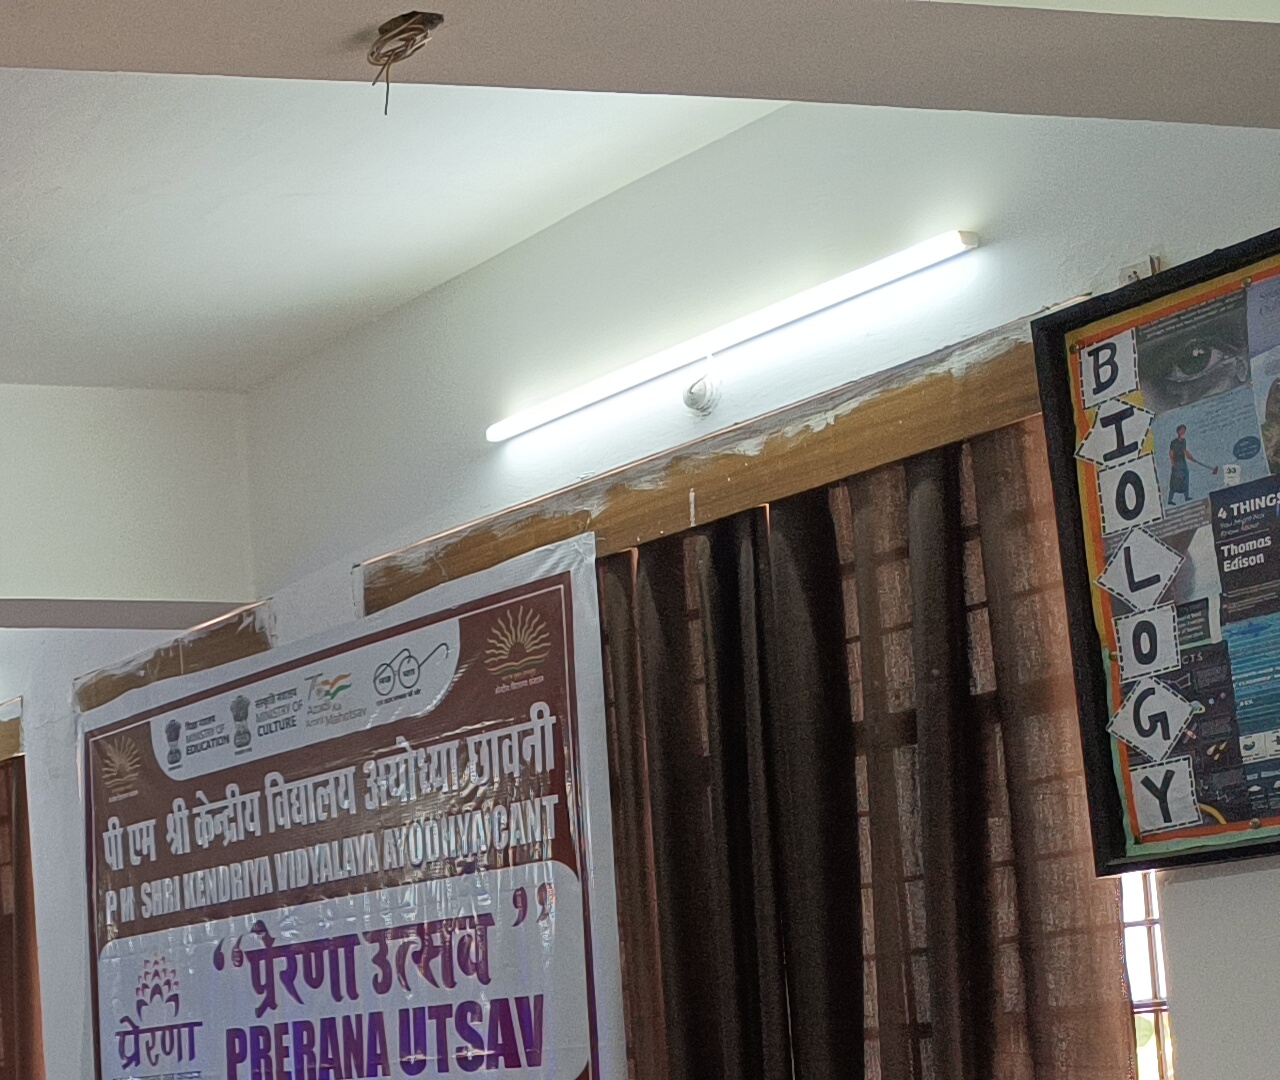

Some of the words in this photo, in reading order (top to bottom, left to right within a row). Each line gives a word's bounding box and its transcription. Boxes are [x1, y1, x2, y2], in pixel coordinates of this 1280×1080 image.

[1218, 507, 1227, 519] 4
[1220, 536, 1272, 557] Thomas
[1223, 553, 1265, 573] Edison
[257, 715, 297, 737] CULTURE
[186, 734, 230, 755] EDUCATION
[102, 816, 124, 871] पी
[127, 819, 157, 866] एम
[166, 797, 190, 855] श्री
[192, 783, 261, 848] केन्द्रीय
[141, 875, 181, 919] SHRI
[183, 856, 274, 910] KENDRIYA
[274, 831, 380, 892] VIDYALAYA
[491, 794, 560, 851] CANT
[115, 1016, 203, 1070] प्रेरणा
[398, 994, 545, 1077] UTSAV
